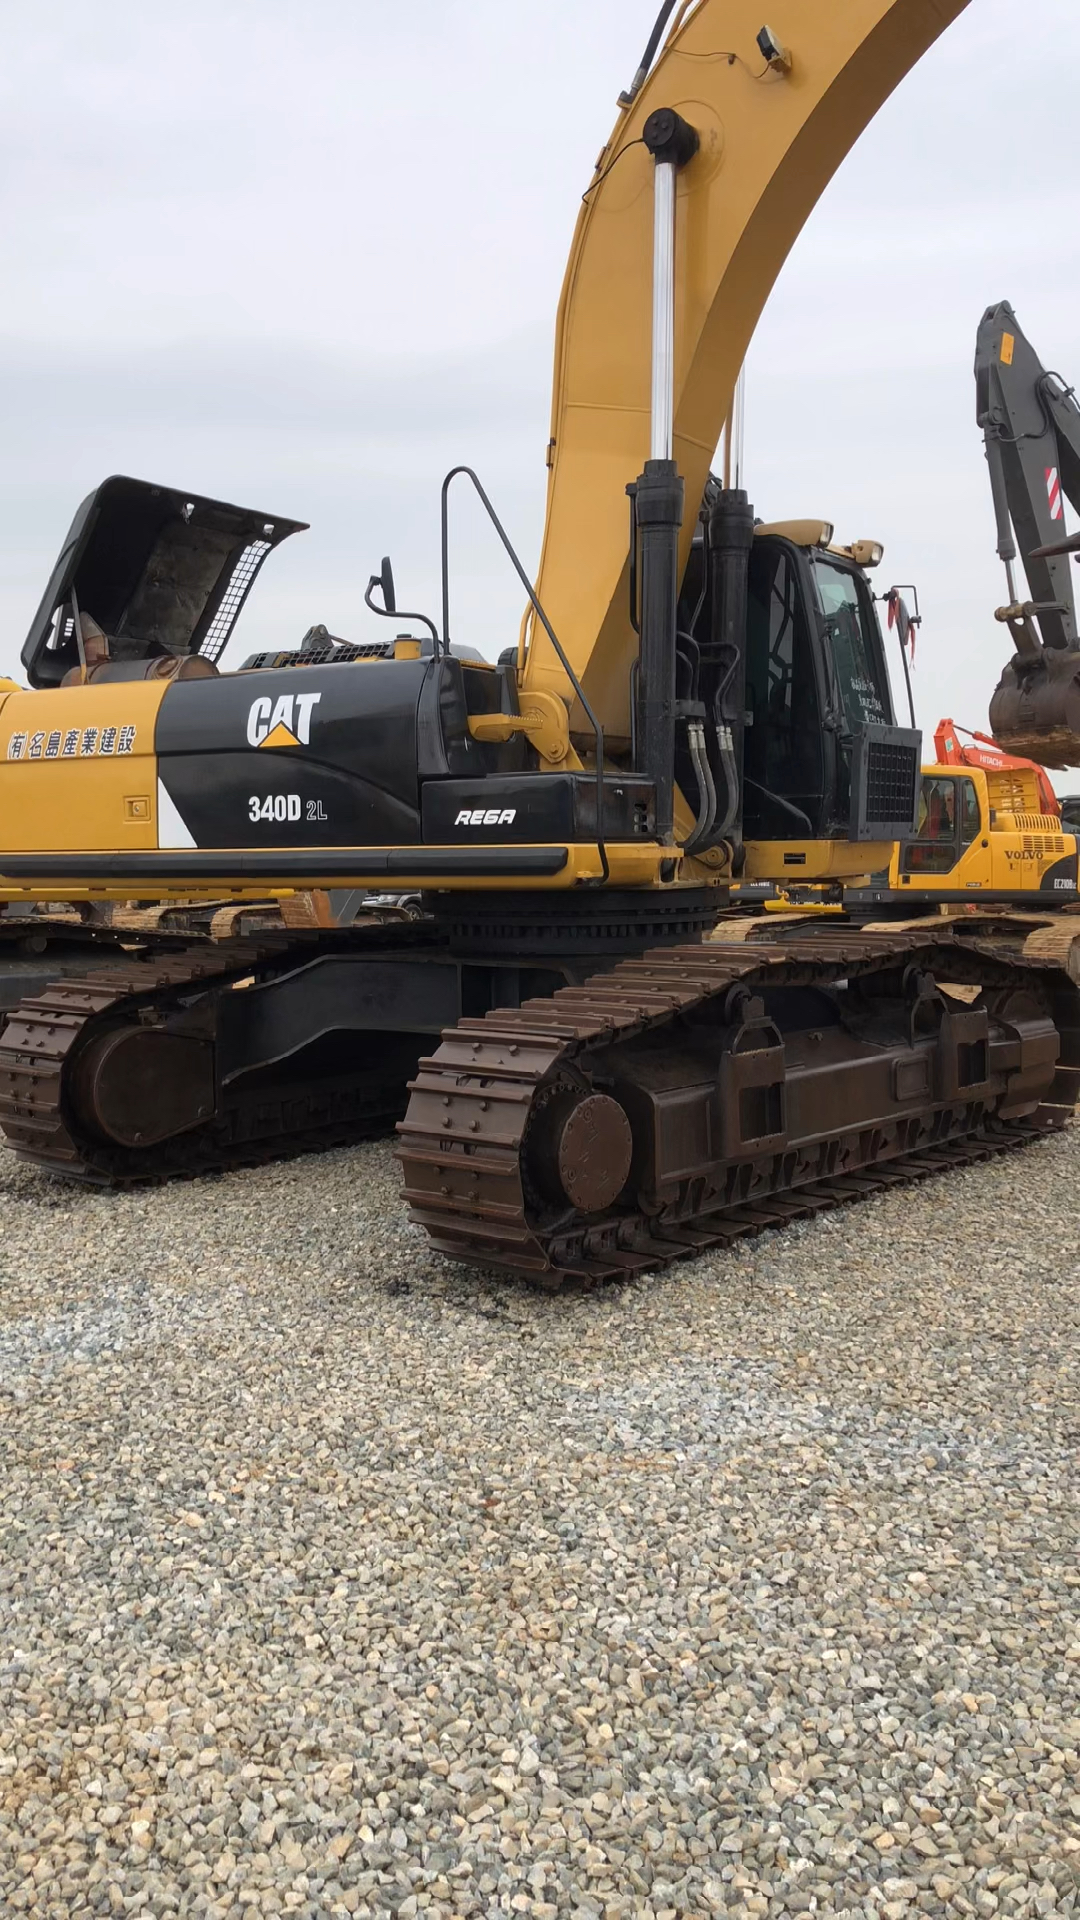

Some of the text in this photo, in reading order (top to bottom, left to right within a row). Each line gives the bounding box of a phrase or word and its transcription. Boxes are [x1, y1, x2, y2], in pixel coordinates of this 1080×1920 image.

[247, 692, 321, 748] CAT
[979, 753, 1003, 768] HITACHI
[248, 794, 328, 822] 340D 2L
[454, 809, 517, 825] REGA
[1004, 850, 1043, 860] VOLVO
